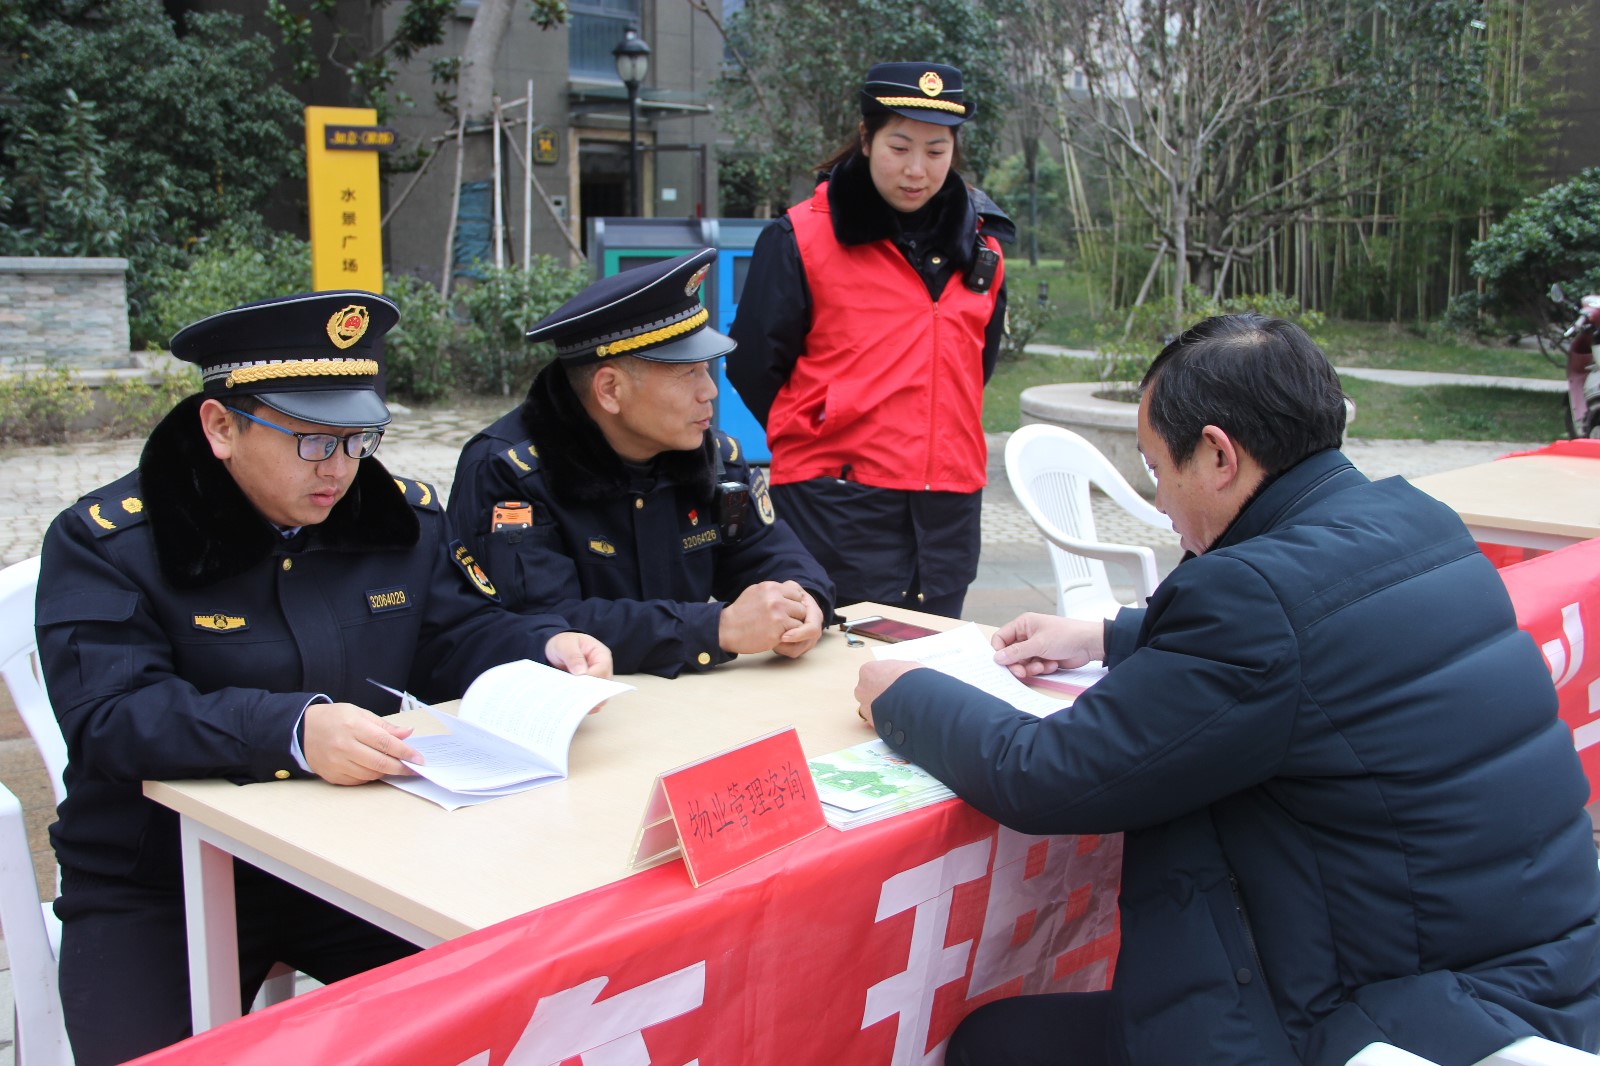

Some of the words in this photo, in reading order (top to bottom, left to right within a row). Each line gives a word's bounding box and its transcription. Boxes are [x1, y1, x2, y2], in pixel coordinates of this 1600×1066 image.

[340, 187, 358, 273] 水景广场
[682, 529, 717, 549] 32064126
[369, 590, 406, 608] 32064029
[687, 760, 807, 844] 物业管理咨询
